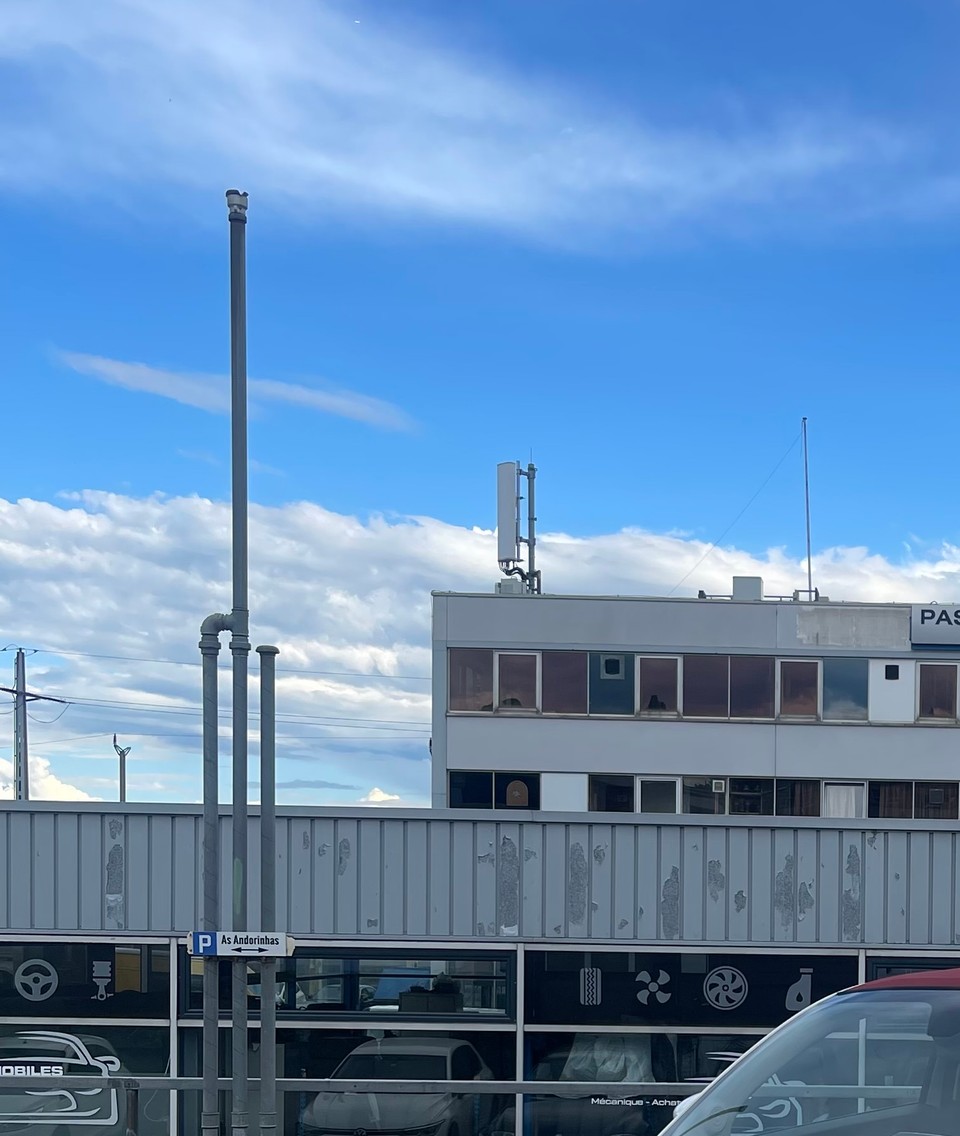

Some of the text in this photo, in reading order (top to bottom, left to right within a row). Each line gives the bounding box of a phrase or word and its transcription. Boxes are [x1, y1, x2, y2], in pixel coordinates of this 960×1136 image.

[198, 934, 212, 953] P
[221, 934, 280, 946] As Andorinhas
[0, 1065, 64, 1076] OBILES
[591, 1097, 644, 1107] Mécanique
